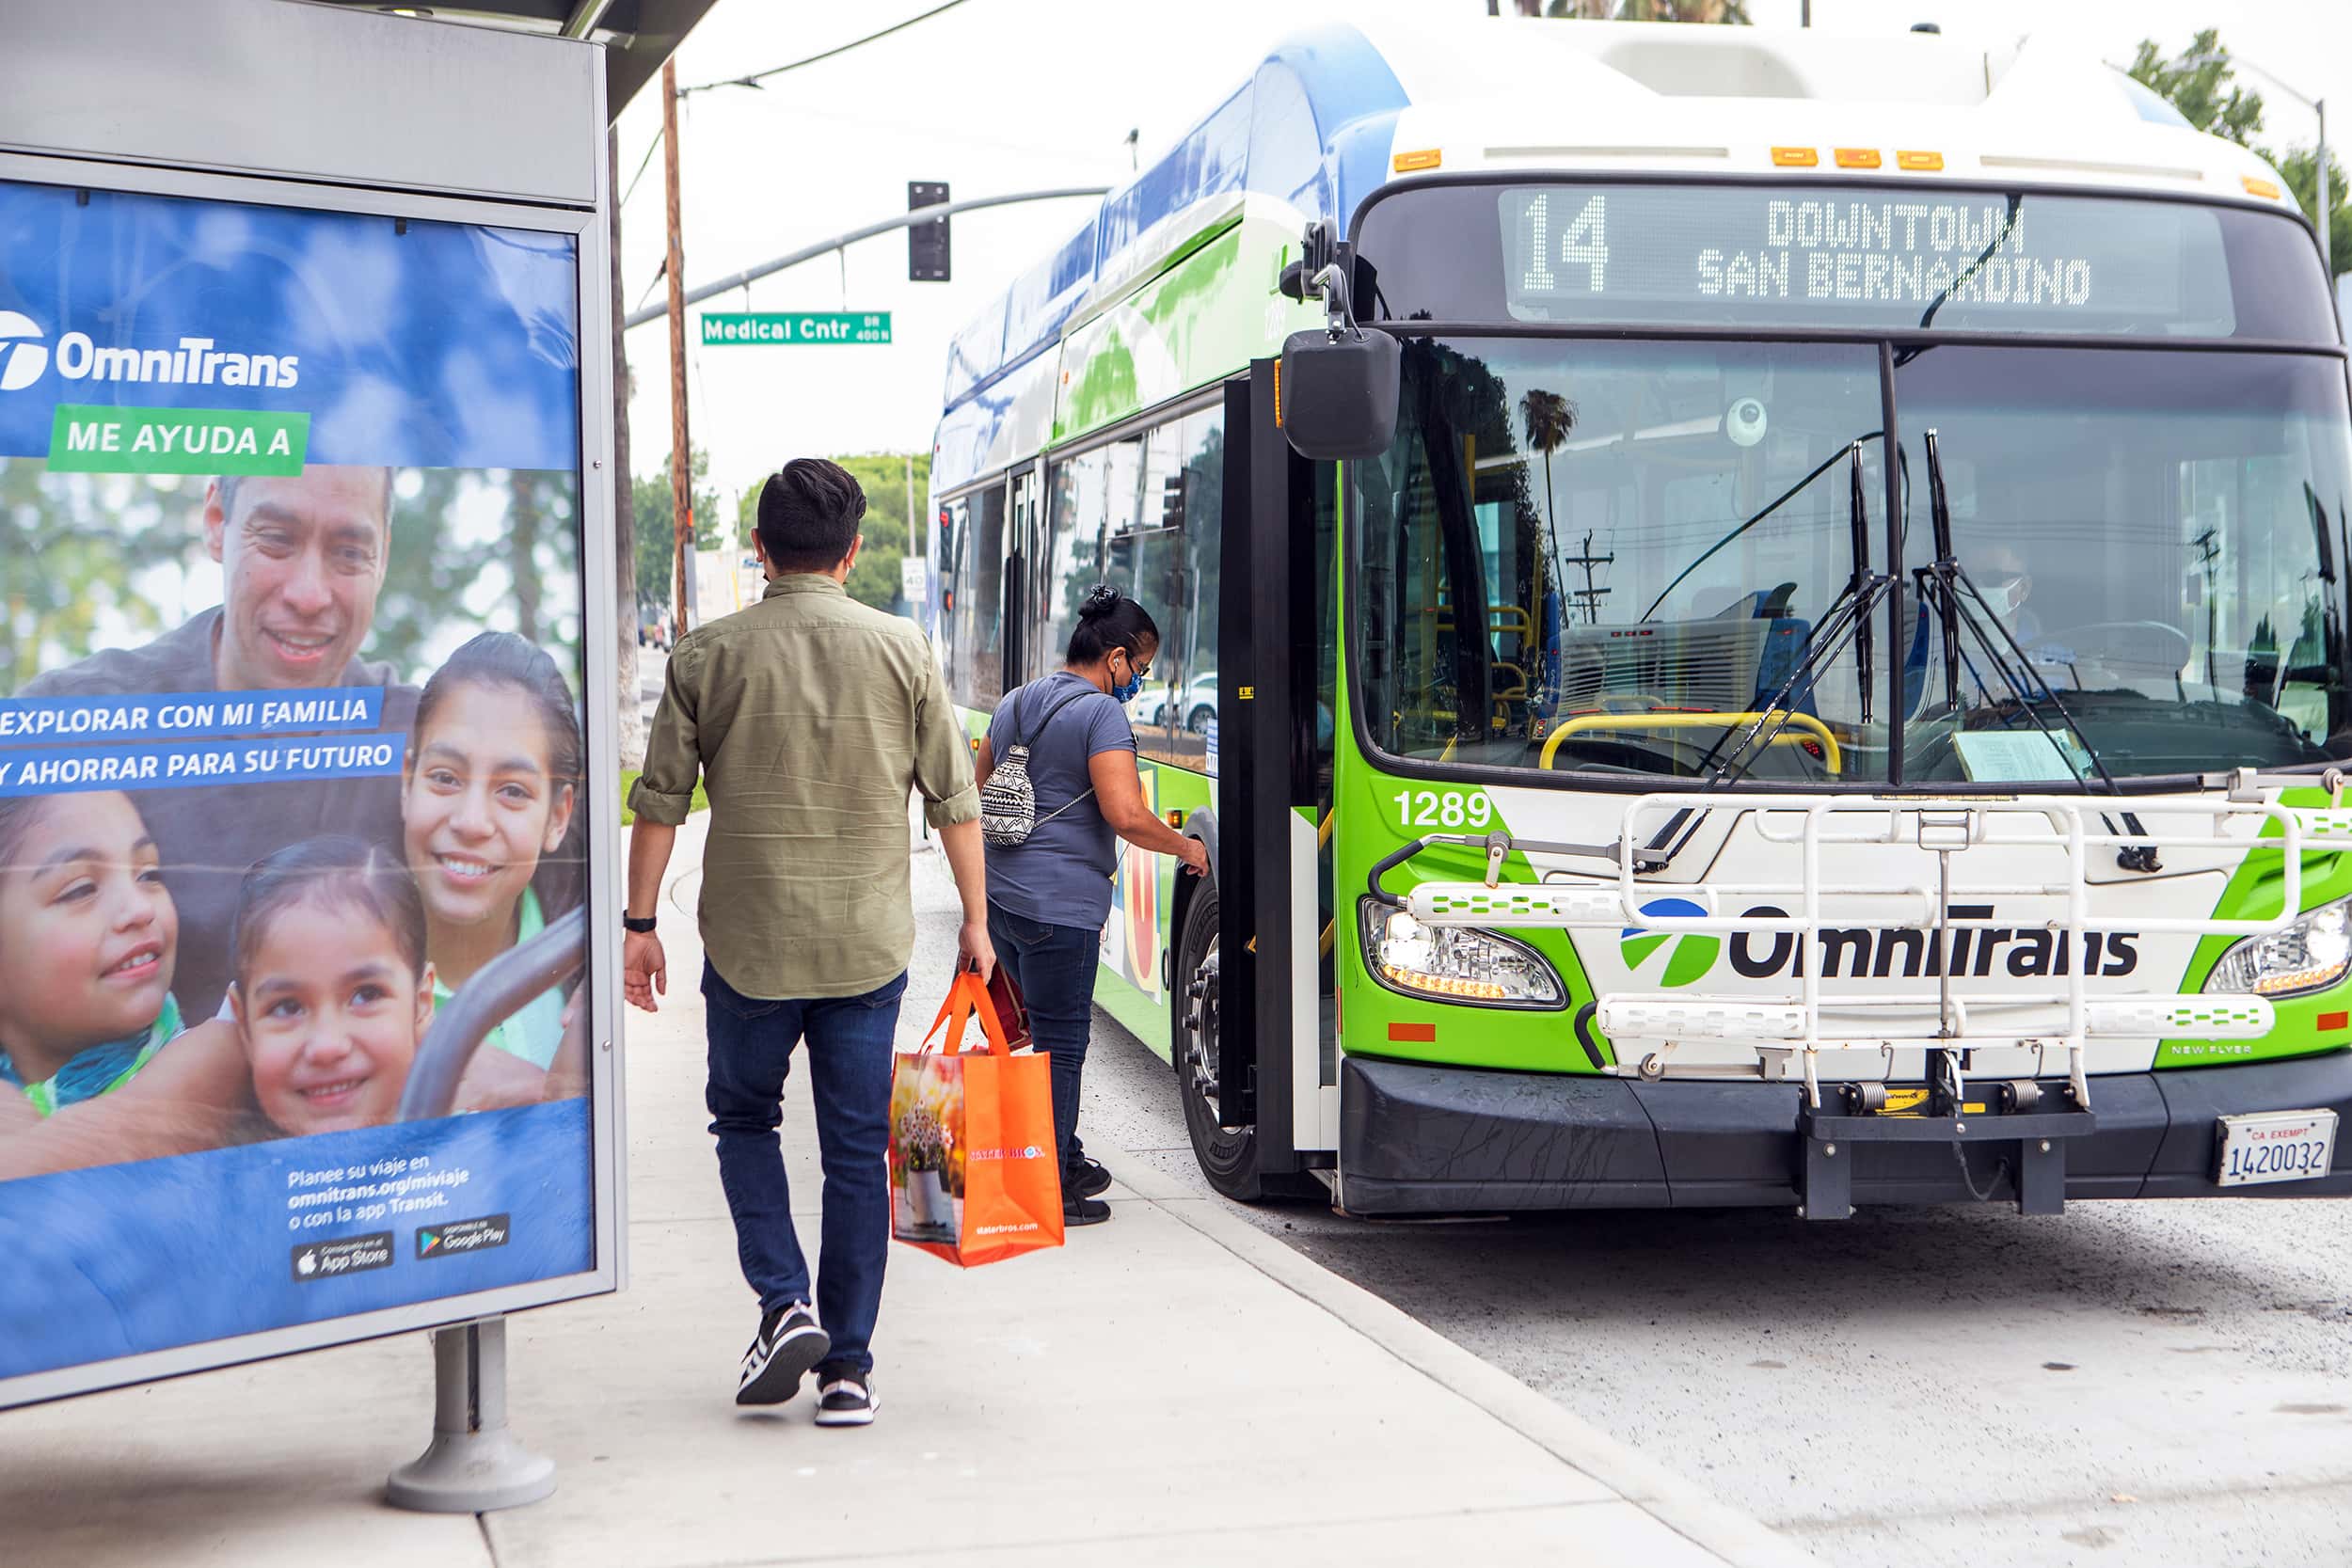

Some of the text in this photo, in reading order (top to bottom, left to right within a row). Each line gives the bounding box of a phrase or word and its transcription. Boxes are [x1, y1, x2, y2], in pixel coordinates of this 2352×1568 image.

[1524, 194, 1609, 293] 14
[1768, 199, 2026, 254] DOWNTOWN
[1697, 248, 2092, 307] SAN BERNARDINO
[704, 317, 851, 341] Medical Cntr
[855, 330, 880, 341] 400
[863, 315, 881, 327] DR
[56, 331, 299, 388] OmniTrans
[67, 421, 292, 456] ME AYUDA A
[0, 699, 369, 736] EXPLORAR CON MI FAMILIA
[0, 744, 393, 785] Y AHORRAR PARA SU FUTURO
[1393, 790, 1491, 828] 1289
[1729, 905, 2140, 978] OmniTrans
[2171, 1044, 2252, 1054] NEW FLYER
[2251, 1128, 2310, 1141] CA EXEMPT
[288, 1155, 430, 1189] Planee su viaje en
[2228, 1140, 2326, 1178] 1420032
[288, 1167, 469, 1210] omnitrans.org/miviaje
[289, 1190, 449, 1231] o con la app Transit.
[977, 1223, 1039, 1235] staterbros.com
[443, 1227, 505, 1250] Google Play
[321, 1249, 389, 1274] App Store
